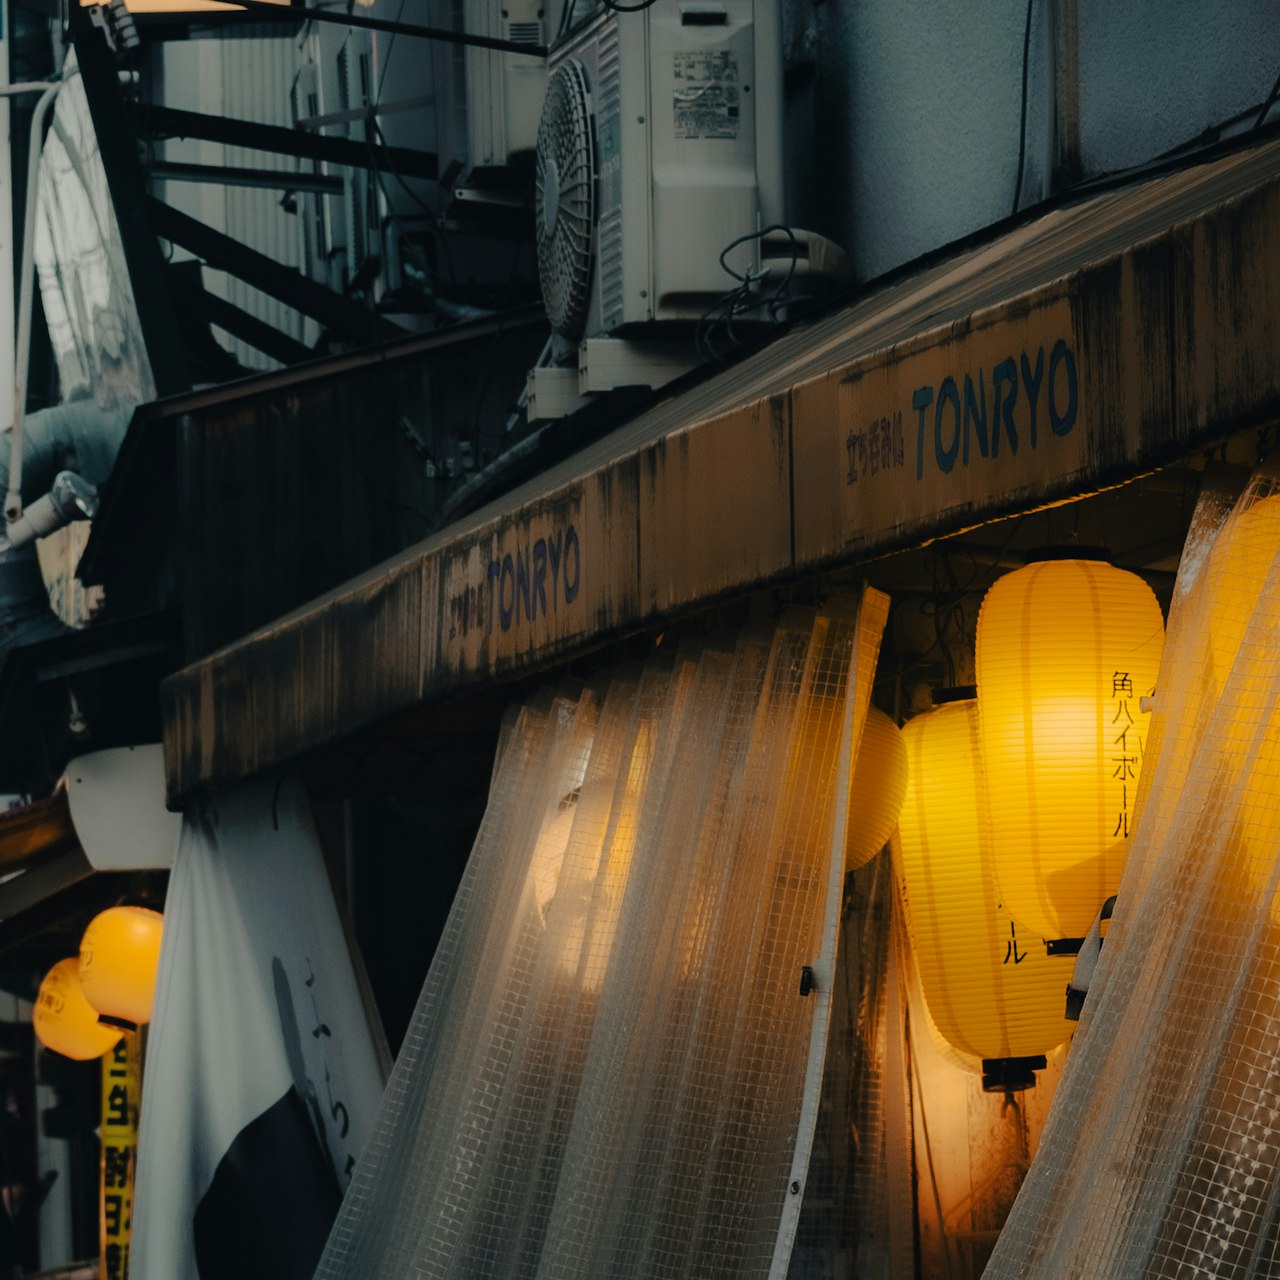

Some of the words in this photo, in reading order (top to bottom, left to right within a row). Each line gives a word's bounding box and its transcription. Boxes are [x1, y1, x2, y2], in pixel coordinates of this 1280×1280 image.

[912, 338, 1079, 481] TONRYO
[486, 524, 581, 636] TONRYO
[1111, 670, 1139, 839] 角ハイボール
